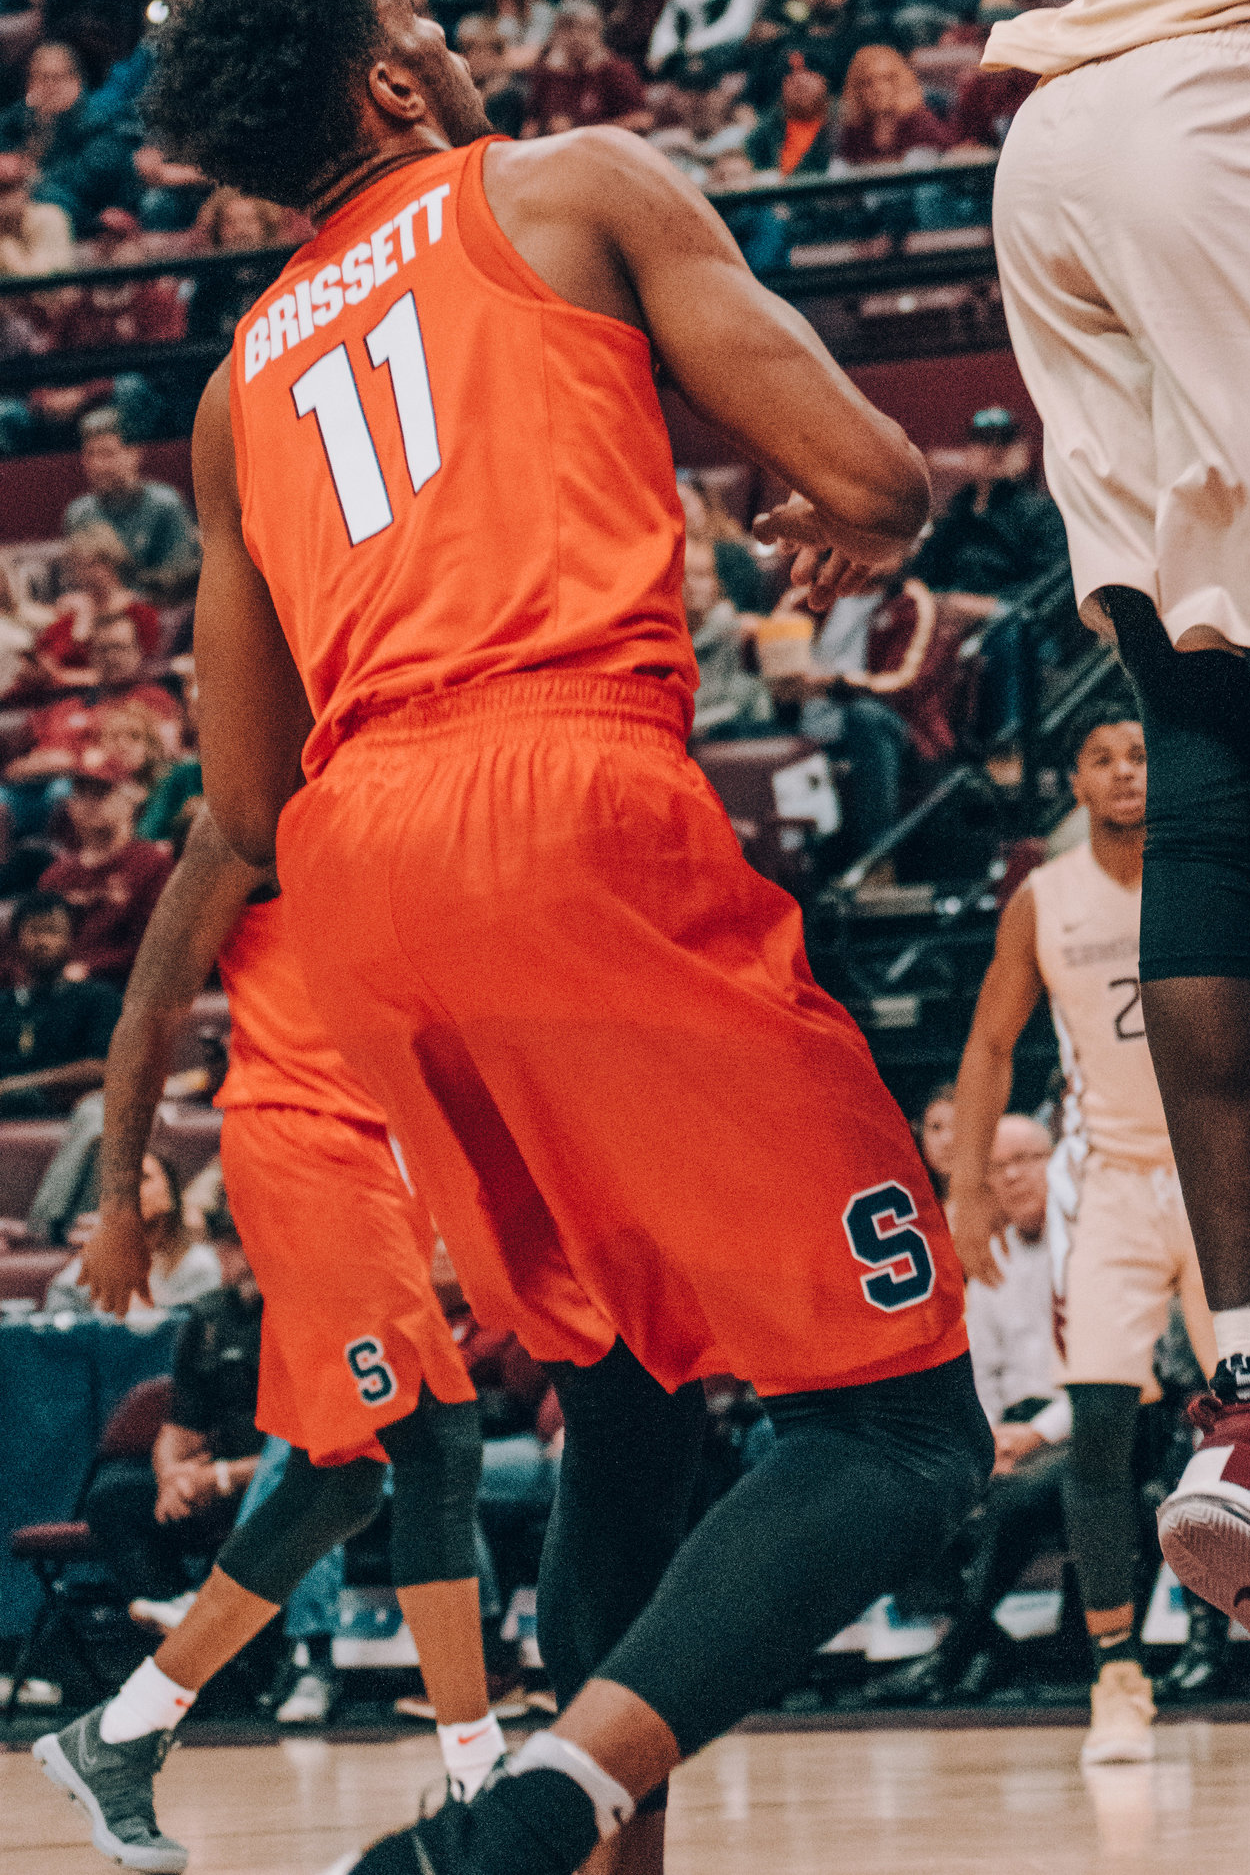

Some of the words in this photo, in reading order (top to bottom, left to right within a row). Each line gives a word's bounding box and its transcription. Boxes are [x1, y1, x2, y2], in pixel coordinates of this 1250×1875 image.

[244, 183, 451, 385] BRISSETT
[289, 287, 443, 548] 11
[841, 1179, 936, 1313] S
[344, 1335, 398, 1407] S
